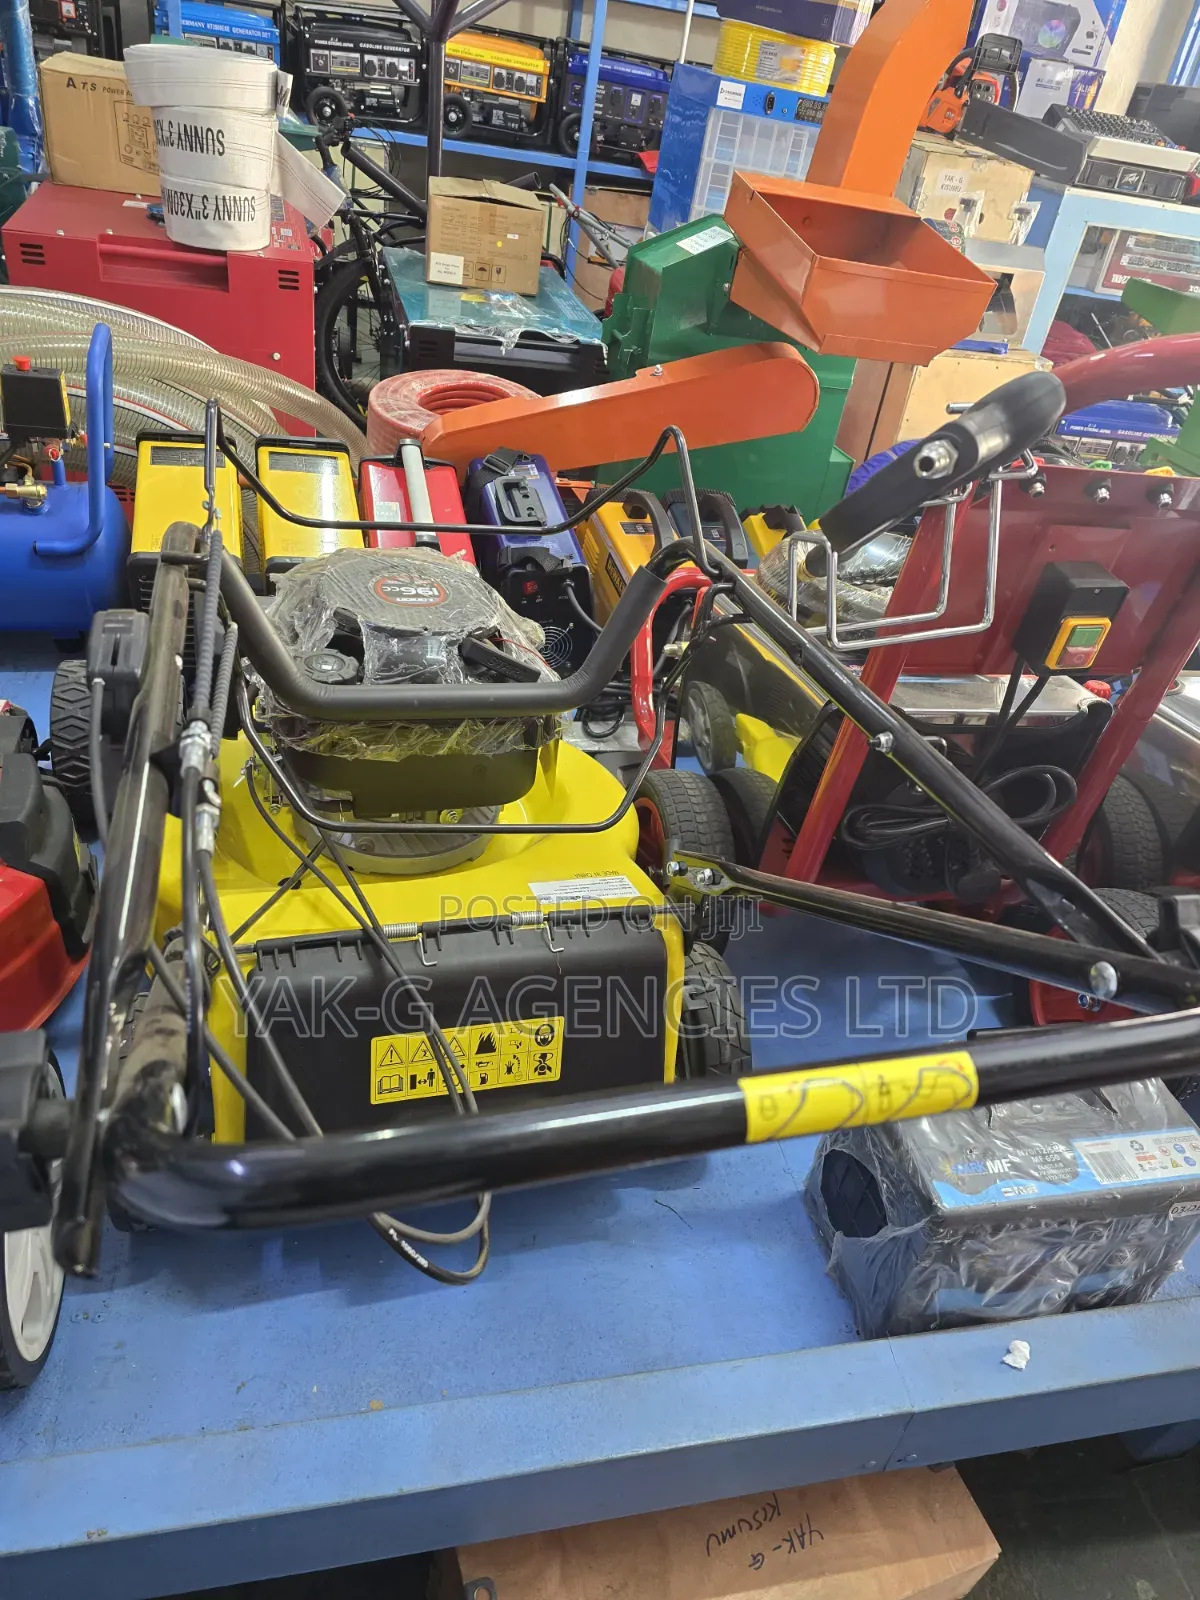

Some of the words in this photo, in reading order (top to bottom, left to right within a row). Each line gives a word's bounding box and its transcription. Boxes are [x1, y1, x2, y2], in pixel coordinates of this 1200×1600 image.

[180, 19, 205, 29] ERMANY
[359, 42, 382, 50] GASOLINE
[383, 45, 411, 53] GENERATOR
[102, 86, 125, 96] POWER
[176, 121, 225, 157] SUNNY
[943, 174, 954, 183] YAK
[212, 194, 256, 222] SUNNY
[1117, 429, 1143, 437] GASOLINE
[382, 586, 440, 597] 196cc
[1031, 1155, 1044, 1164] MF
[985, 1158, 1012, 1174] MF
[747, 1550, 766, 1571] G
